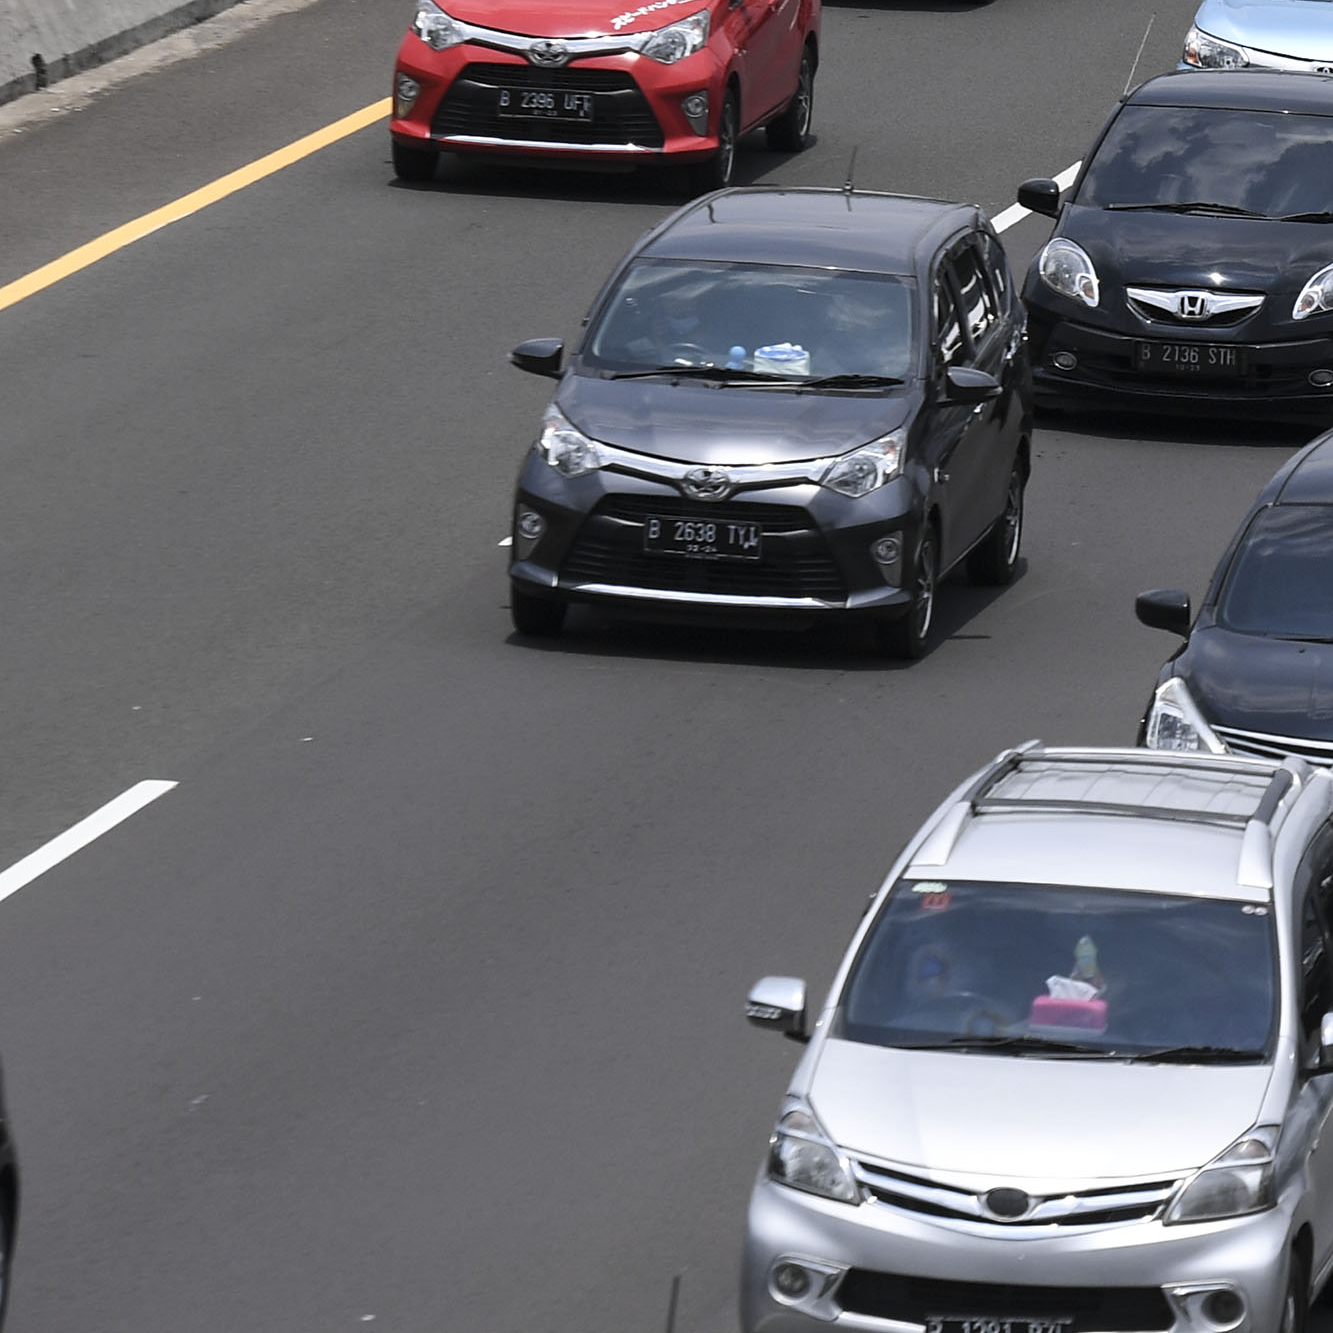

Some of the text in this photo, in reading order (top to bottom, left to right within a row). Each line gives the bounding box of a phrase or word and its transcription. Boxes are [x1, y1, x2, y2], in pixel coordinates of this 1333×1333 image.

[500, 90, 510, 106] B
[521, 91, 555, 109] 2396
[1141, 344, 1236, 366] B 2136 STH
[648, 519, 660, 539] B
[674, 521, 716, 543] 2638
